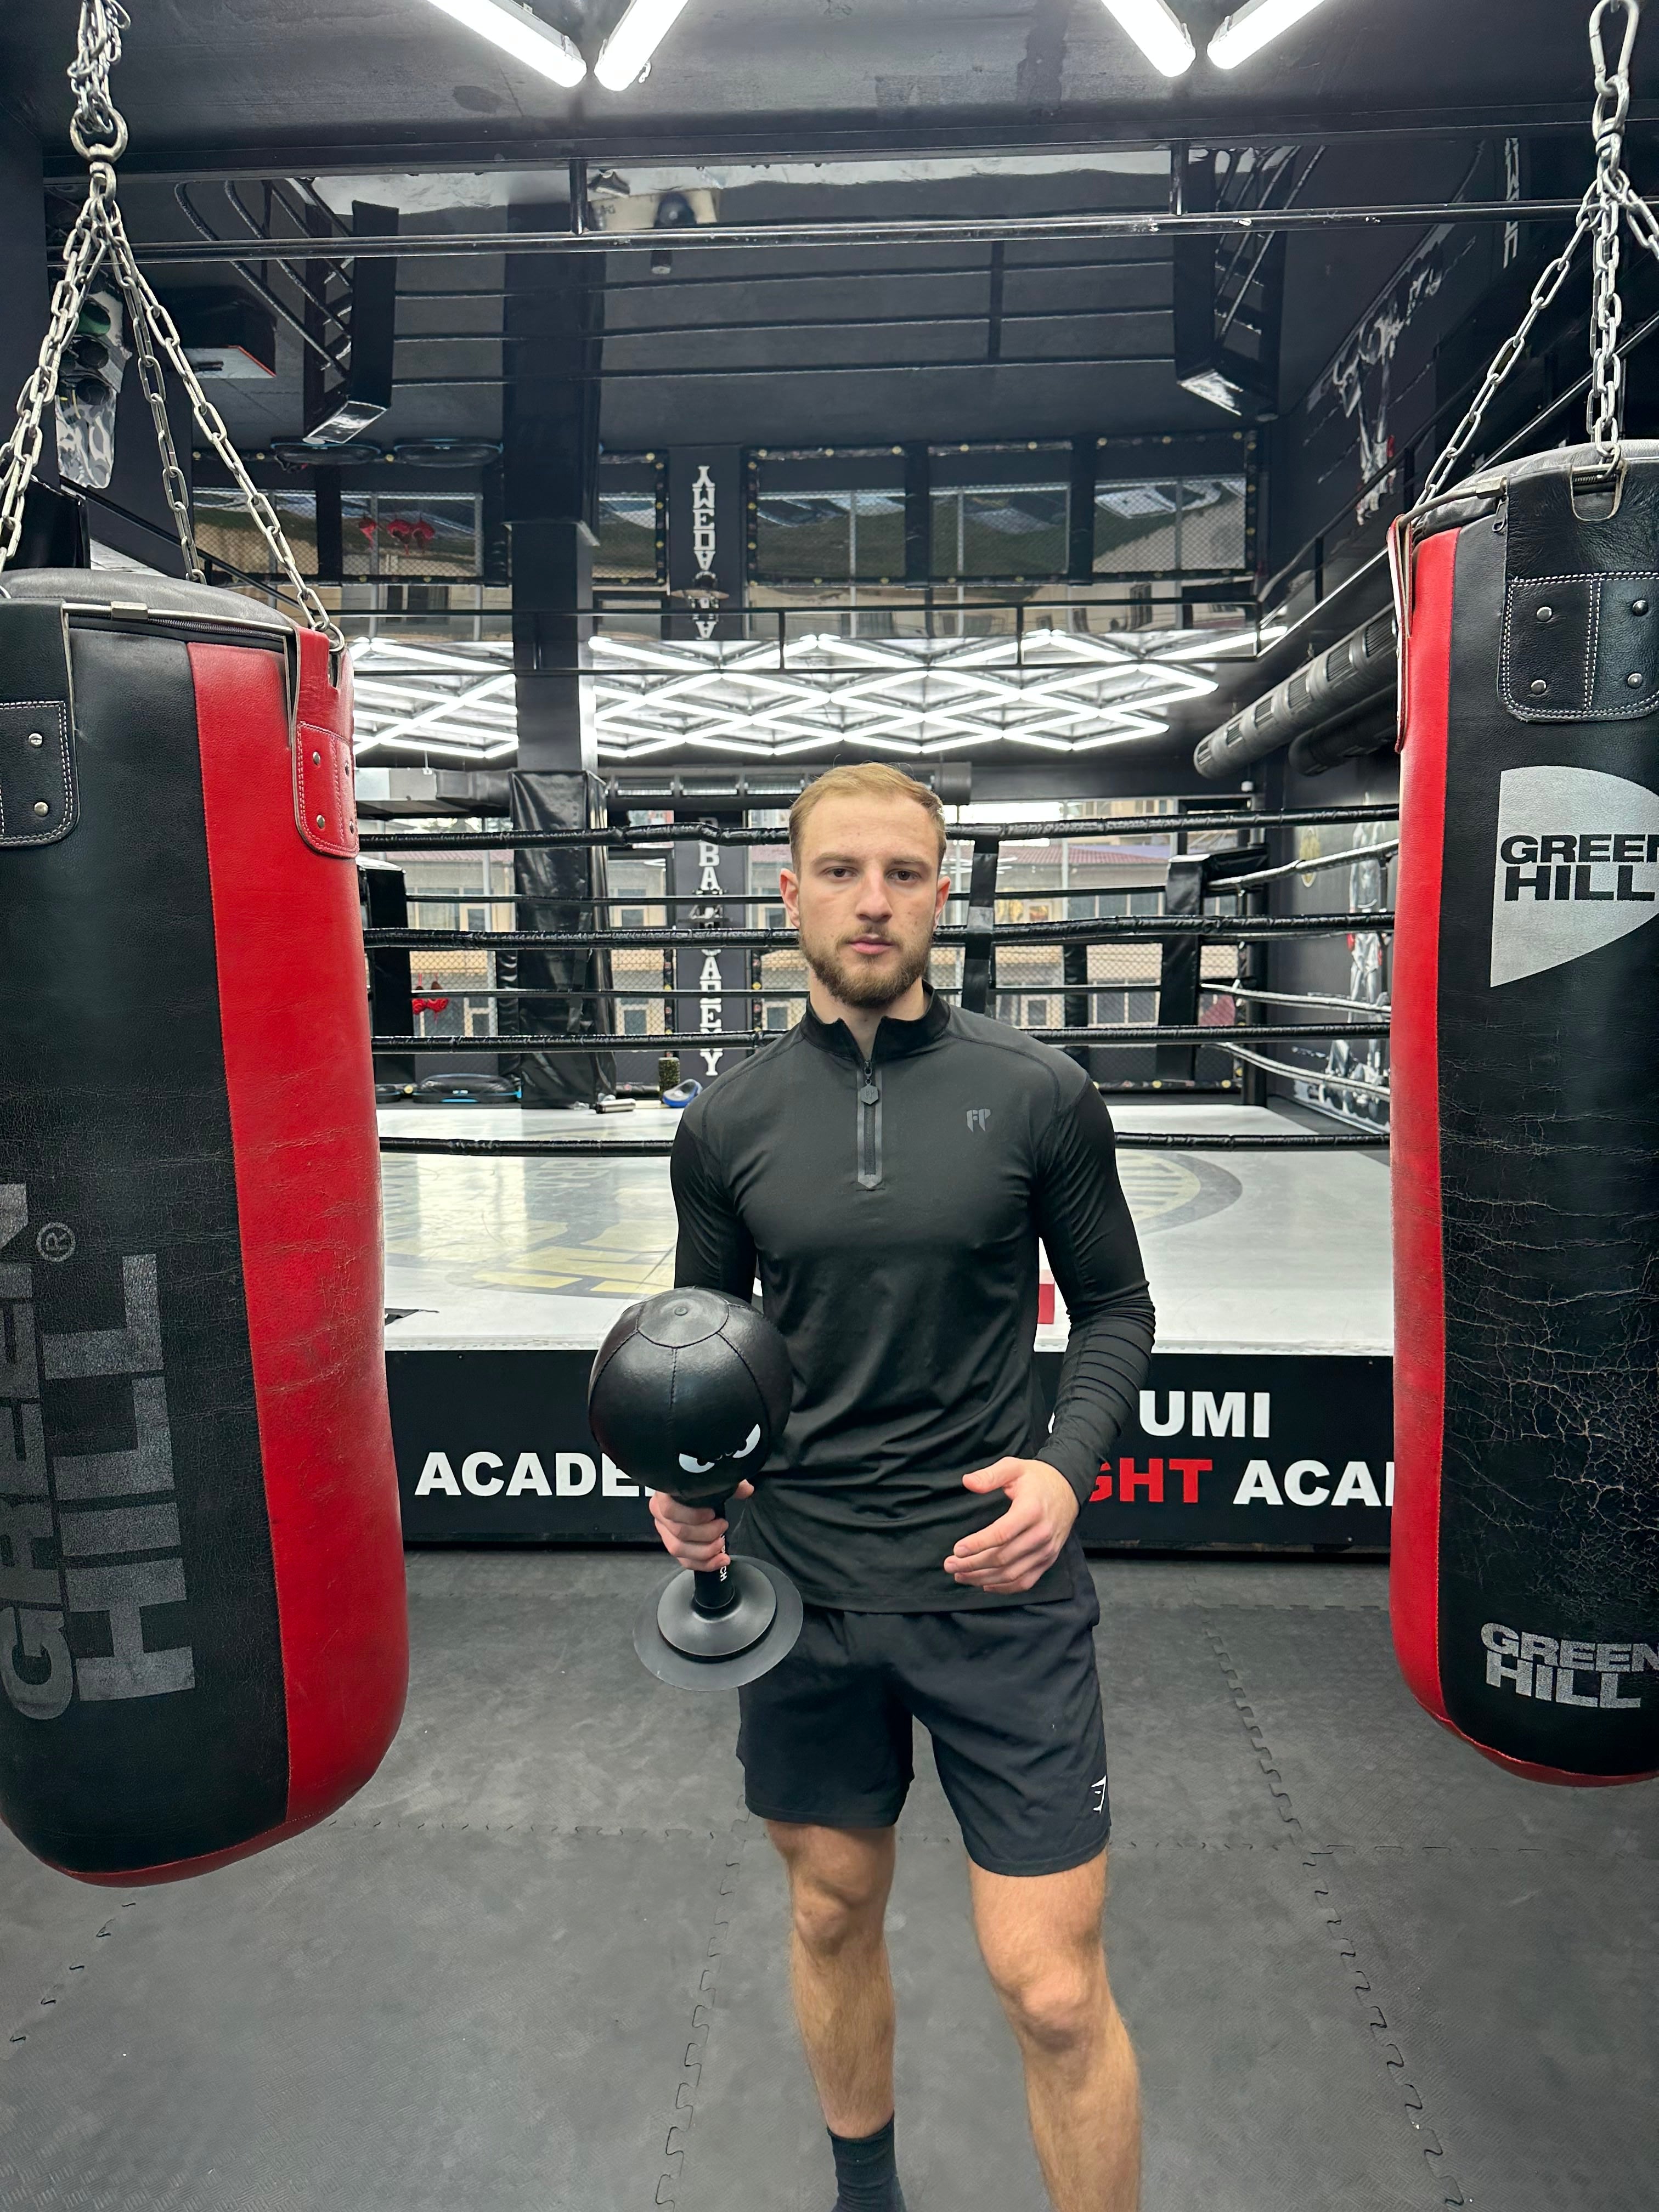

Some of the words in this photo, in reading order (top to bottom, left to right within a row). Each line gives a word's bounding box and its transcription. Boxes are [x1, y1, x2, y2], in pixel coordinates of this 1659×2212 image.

[1504, 865, 1655, 901] HILL
[43, 1254, 196, 1701] HILL
[414, 1451, 656, 1497] ACADE
[1233, 1459, 1394, 1506] ACA
[1481, 1622, 1659, 1673] GREEN
[1486, 1650, 1641, 1709] HILL
